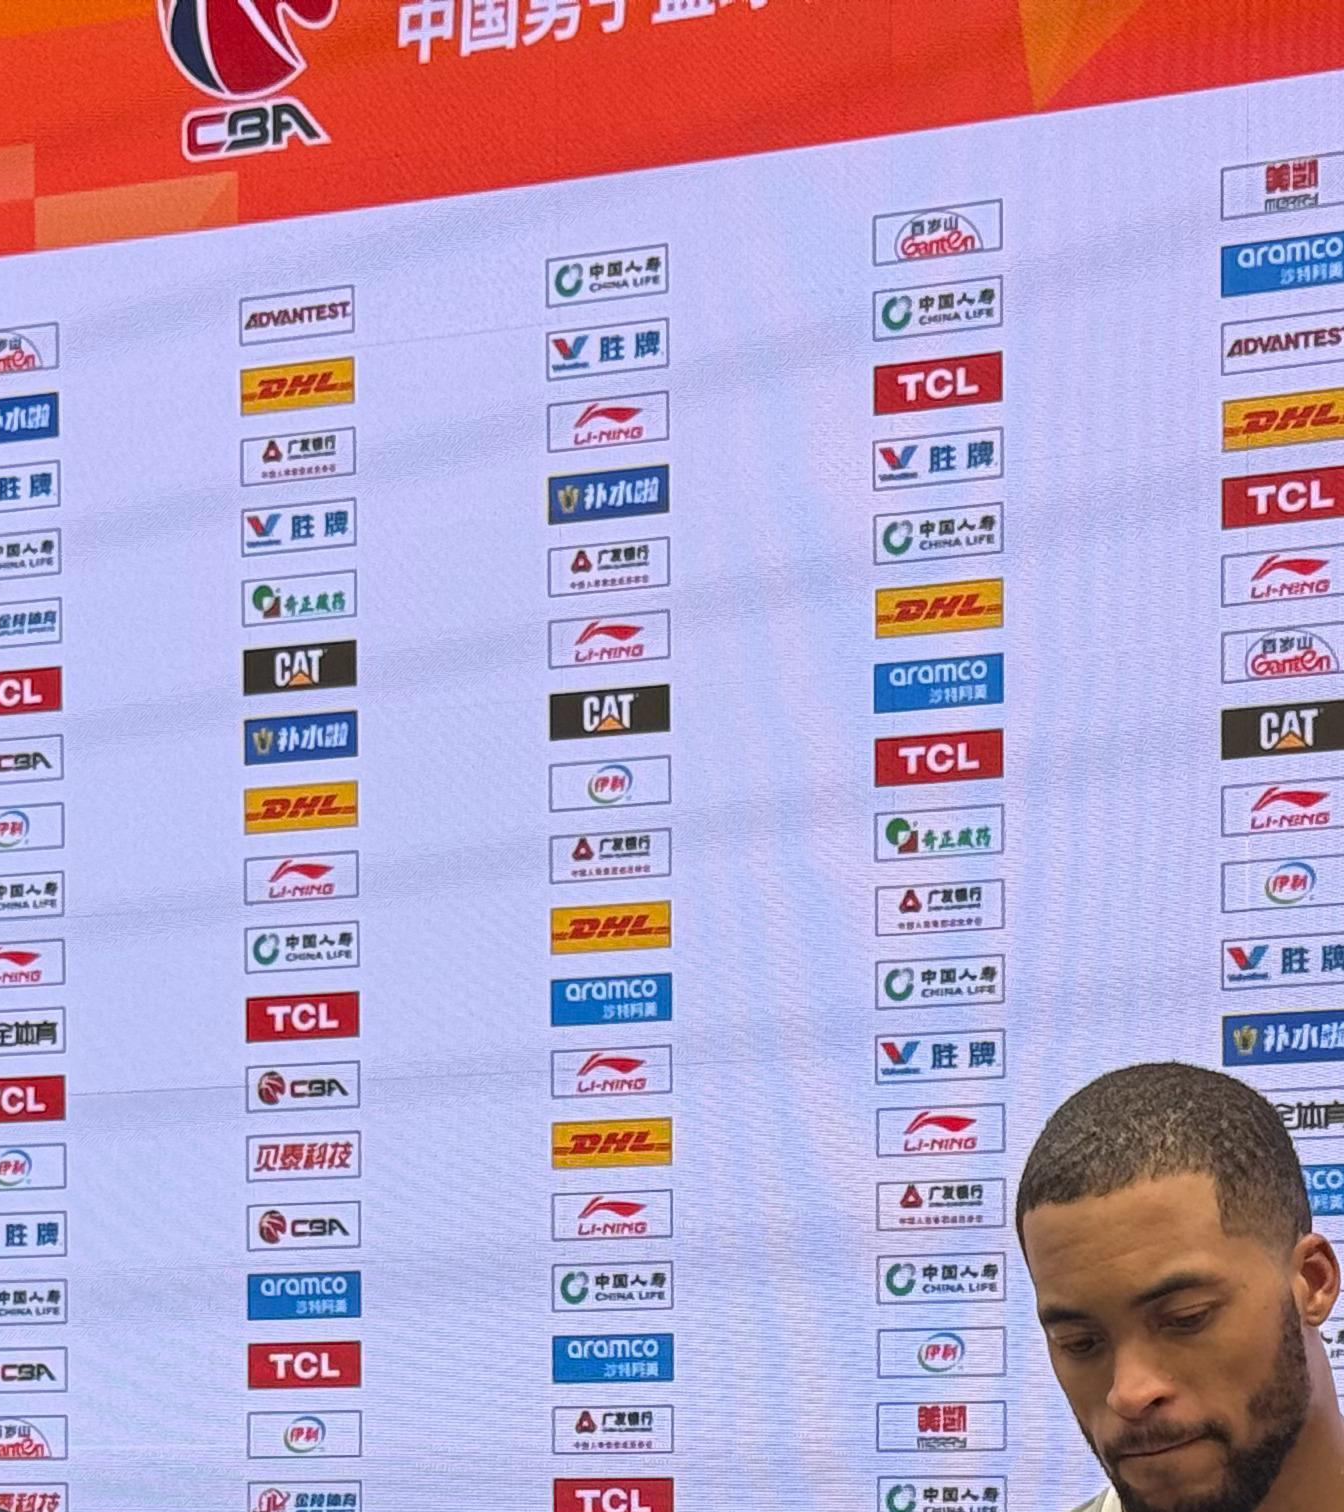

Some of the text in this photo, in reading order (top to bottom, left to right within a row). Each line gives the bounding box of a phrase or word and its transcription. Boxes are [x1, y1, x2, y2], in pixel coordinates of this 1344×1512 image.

[187, 103, 322, 156] CBA
[909, 215, 956, 236] 百岁山
[1237, 236, 1343, 269] aramco
[917, 287, 993, 312] 中国人寿
[598, 330, 659, 363] 胜牌
[256, 370, 338, 400] DHL
[896, 365, 978, 403] TCL
[1240, 401, 1339, 434] DHL
[928, 439, 993, 472] 胜牌
[1246, 478, 1334, 516] TCL
[291, 510, 348, 540] 胜牌
[1250, 579, 1330, 598] LI-NING
[892, 593, 984, 622] DHL
[1261, 635, 1312, 654] 百岁山
[275, 649, 322, 687] CAT
[889, 660, 987, 687] aramco
[583, 692, 633, 732] CAT
[1259, 708, 1317, 751] CAT
[1250, 812, 1330, 829] LI-NING
[567, 914, 653, 940] DHL
[285, 932, 351, 950] 中国人寿
[921, 965, 996, 985] 中国人寿
[565, 979, 656, 1001] aramco
[289, 1078, 348, 1098] CBA
[903, 1137, 977, 1151] LI-NING
[5, 1222, 59, 1246] 胜牌
[260, 1276, 347, 1296] aramco
[0, 1362, 56, 1380] CBA
[268, 1351, 340, 1380] TCL
[922, 1486, 998, 1501] 中国人寿
